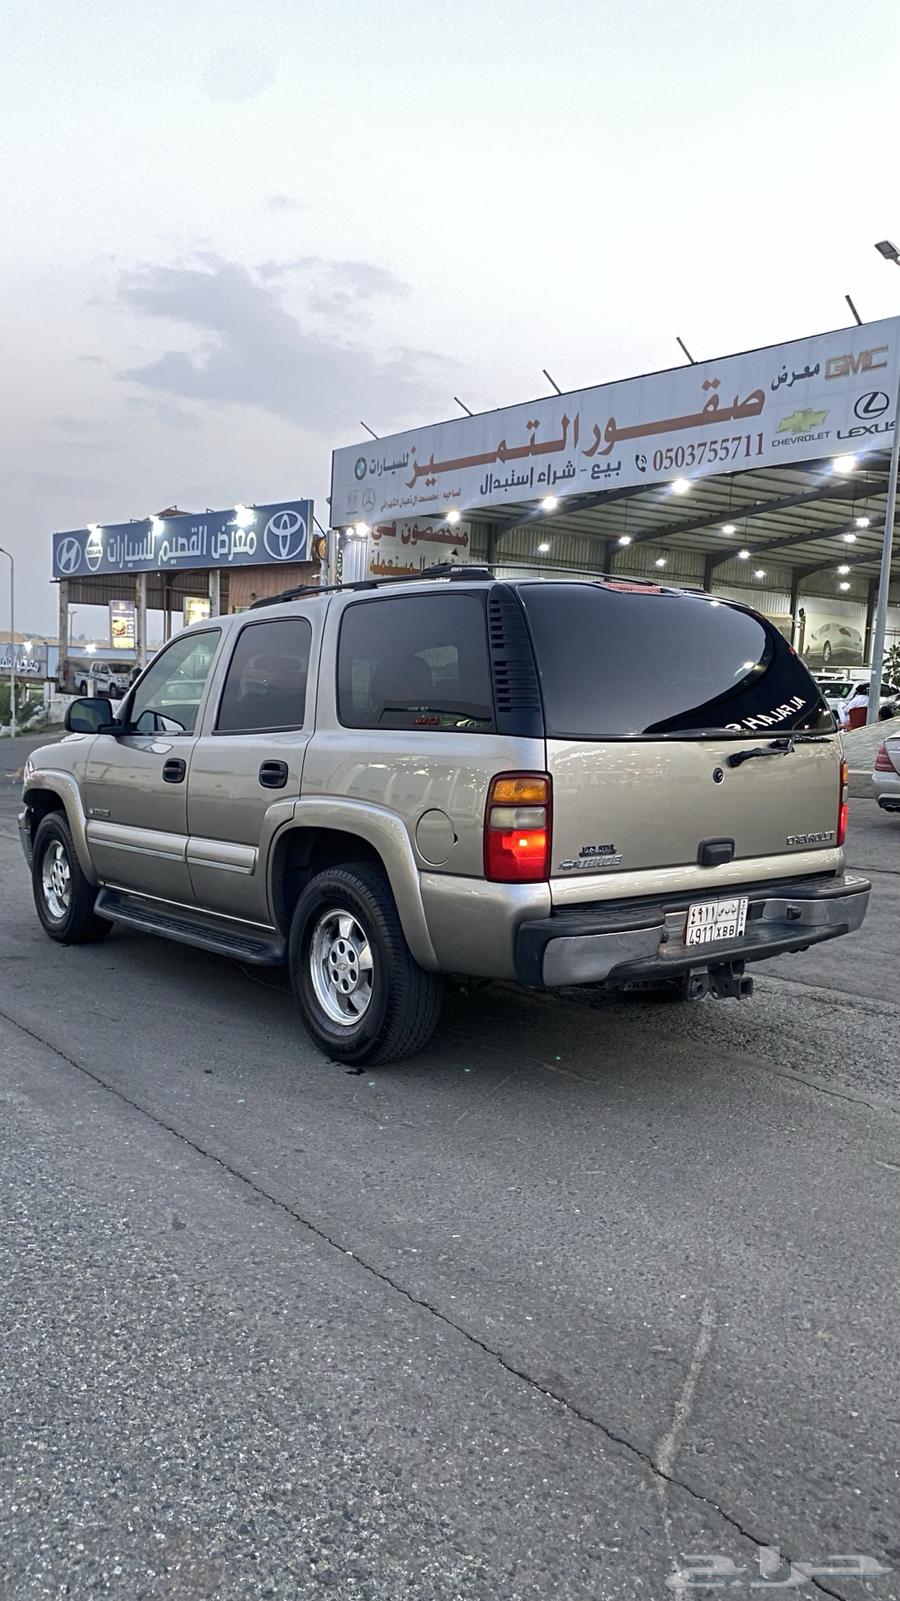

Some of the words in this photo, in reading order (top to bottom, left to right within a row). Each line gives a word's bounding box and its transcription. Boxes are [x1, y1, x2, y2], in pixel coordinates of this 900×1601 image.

[824, 344, 889, 381] GMC
[771, 363, 820, 391] معرض
[581, 378, 766, 457] صقور
[405, 412, 581, 489] التميز
[652, 432, 766, 472] 0503755711
[771, 431, 831, 448] CHEVROLET
[369, 452, 409, 477] للسيارات
[536, 460, 577, 487] شراء
[590, 460, 622, 479] بيع
[157, 525, 208, 566] القصيم
[211, 526, 257, 561] معرض
[371, 521, 397, 546] في
[401, 521, 469, 548] متخصصون
[107, 530, 155, 568] للسيارات
[689, 925, 714, 945] 4911
[716, 925, 736, 938] XBB
